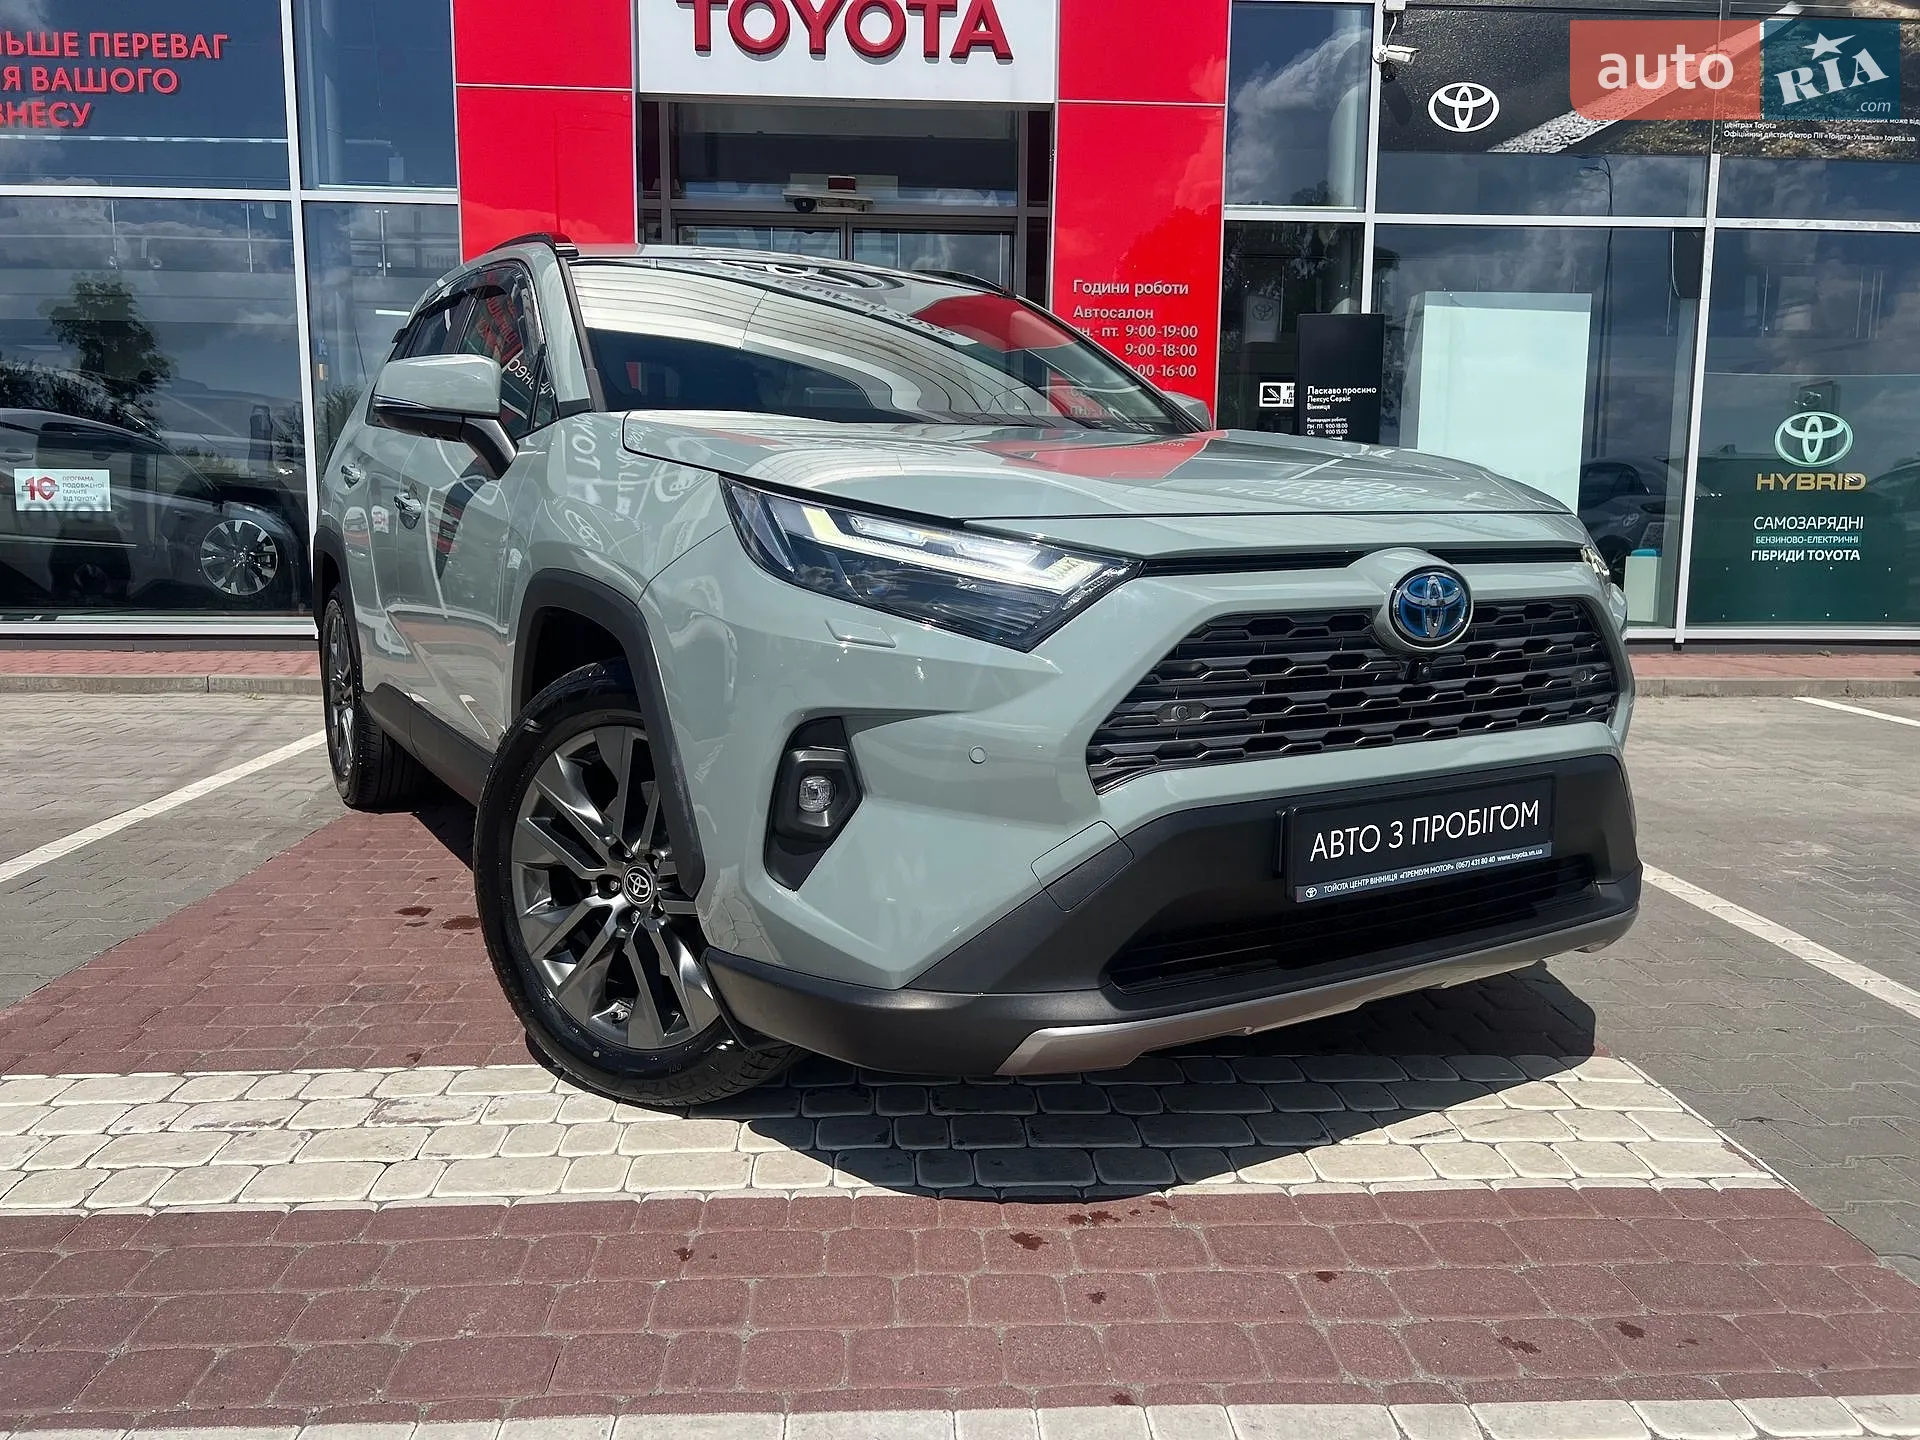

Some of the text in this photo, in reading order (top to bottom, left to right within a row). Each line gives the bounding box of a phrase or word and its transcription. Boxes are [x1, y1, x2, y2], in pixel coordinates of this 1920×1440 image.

[676, 0, 1014, 61] TOYOTA
[0, 30, 228, 60] ЬШЕ ПЕРЕВАГ
[31, 67, 178, 94] ВАШОГО
[1754, 121, 1777, 130] Toyota
[1073, 279, 1189, 297] Години роботи
[1073, 305, 1154, 319] Автосалон
[1125, 324, 1198, 338] 9:00-19:00
[1125, 343, 1198, 357] 9:00-18:00
[1307, 385, 1377, 396] Ласкаво просимо
[1756, 472, 1867, 491] HYBRID
[1753, 516, 1864, 532] САМОЗАРЯДНІ
[1755, 535, 1859, 544] БЕНЗИНОВО-ЕЛЕКТРИЧНІ
[1751, 549, 1861, 562] ГІБРИДИ TOYOTA
[1309, 824, 1381, 862] АВТО
[1412, 799, 1539, 845] ПРОБІГОМ
[1323, 882, 1349, 893] ТОЙОТА
[1350, 878, 1370, 889] ЦЕНТР
[1370, 873, 1398, 885] ВІННИЦЯ
[1455, 859, 1470, 870] (067)
[1471, 858, 1481, 867] 431
